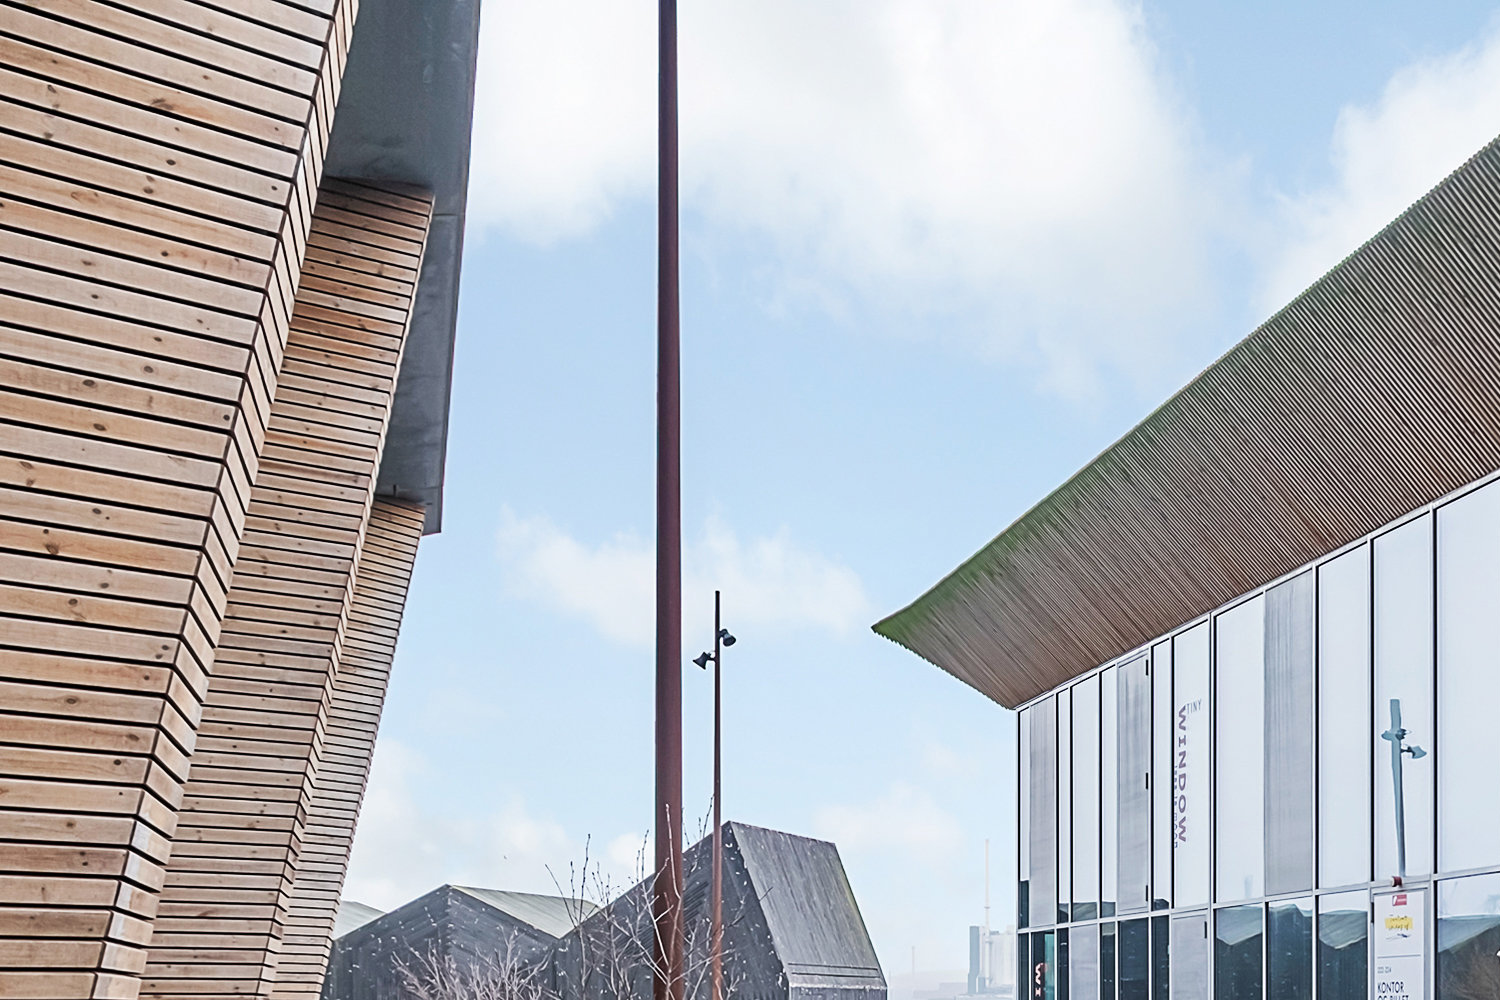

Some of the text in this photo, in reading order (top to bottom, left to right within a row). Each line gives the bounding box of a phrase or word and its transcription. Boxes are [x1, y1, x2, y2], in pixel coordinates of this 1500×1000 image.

[1186, 698, 1202, 715] TINY
[1178, 705, 1187, 842] WINDOW
[1377, 981, 1404, 994] KONTOR
